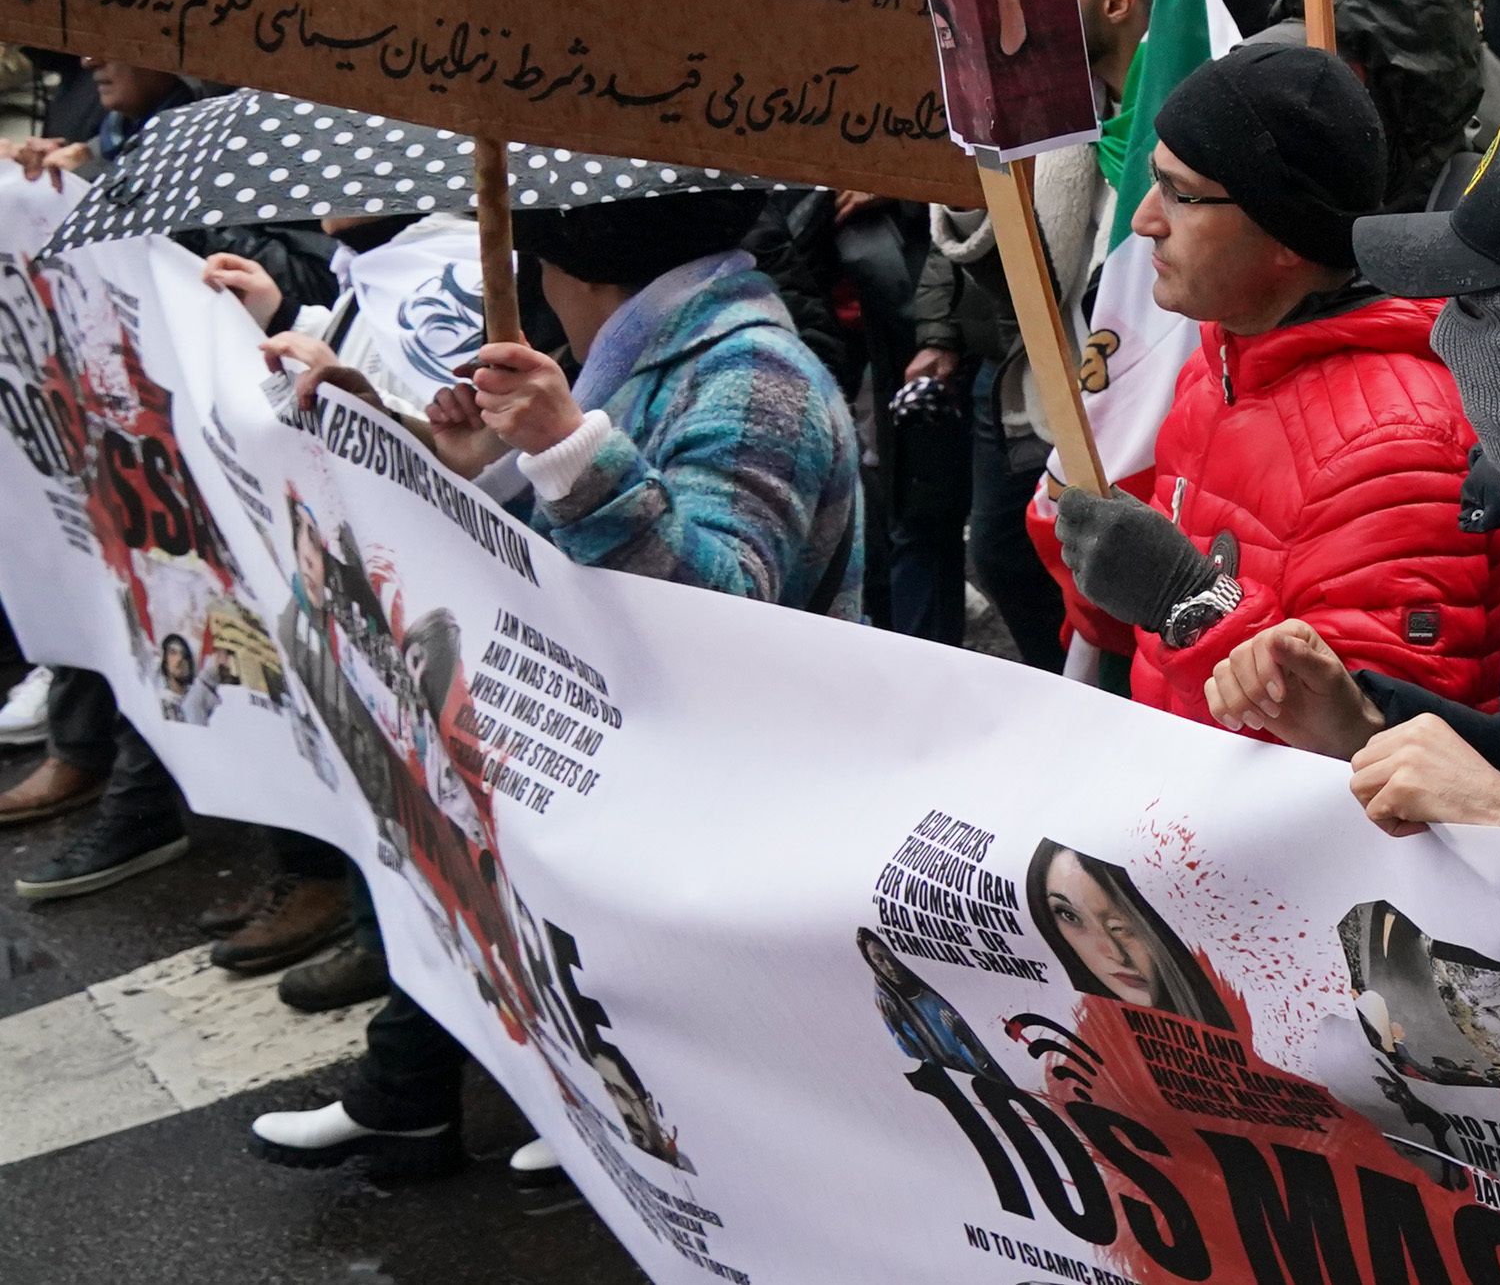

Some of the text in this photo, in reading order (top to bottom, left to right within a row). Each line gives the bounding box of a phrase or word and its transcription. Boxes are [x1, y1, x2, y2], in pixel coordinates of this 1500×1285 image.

[255, 0, 399, 71] سیاسی
[378, 17, 512, 94] زندانیان
[503, 37, 592, 102] شرط
[594, 52, 708, 124] قید
[745, 64, 861, 132] آزادی
[704, 72, 748, 136] بی
[327, 403, 433, 505] RESISTANCE
[431, 466, 541, 589] REVOLUTION
[494, 607, 503, 632] I
[500, 611, 519, 641] AM
[468, 671, 605, 758] WHEN I WAS SHOT AND
[481, 640, 624, 731] AND I WAS 26 YEARS OLD
[482, 757, 556, 816] DURING THE
[491, 719, 513, 751] IN
[505, 729, 536, 762] THE
[527, 741, 584, 790] STREETS
[576, 768, 602, 797] OF
[912, 808, 996, 864] ACID ATTACKS
[874, 862, 1025, 938] FOR WOMEN WITH
[891, 834, 1021, 913] THROUGHOUT IRAN
[976, 928, 1016, 956] OR
[1120, 1006, 1249, 1069] MILITIA AND
[1134, 1032, 1242, 1088] OFFICIALS
[1445, 1112, 1486, 1142] NO
[963, 1223, 992, 1253] NO
[989, 1230, 1018, 1261] TO
[1015, 1236, 1093, 1285] ISLAMIC
